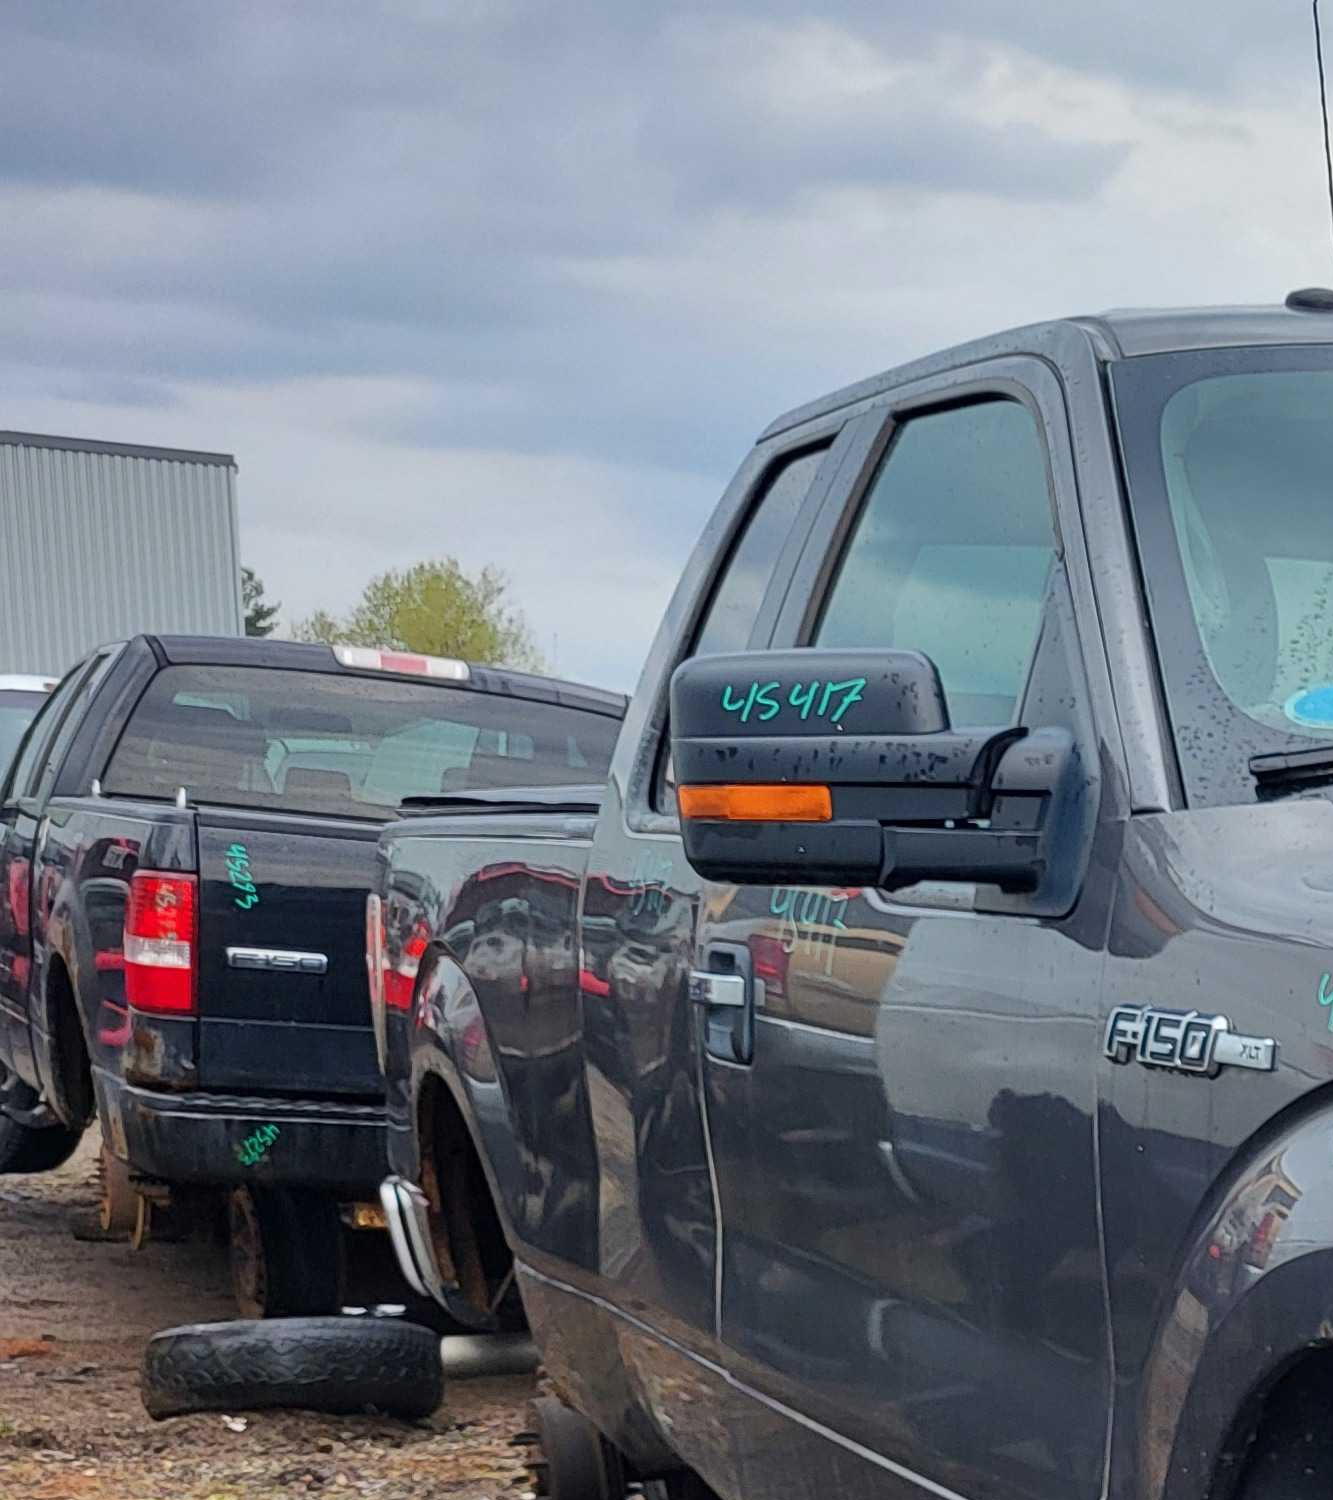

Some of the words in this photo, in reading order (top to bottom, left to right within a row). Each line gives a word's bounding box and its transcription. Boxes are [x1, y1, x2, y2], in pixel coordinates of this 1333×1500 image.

[722, 678, 866, 722] 45417
[225, 842, 259, 909] 45293
[1238, 1042, 1262, 1061] XLT
